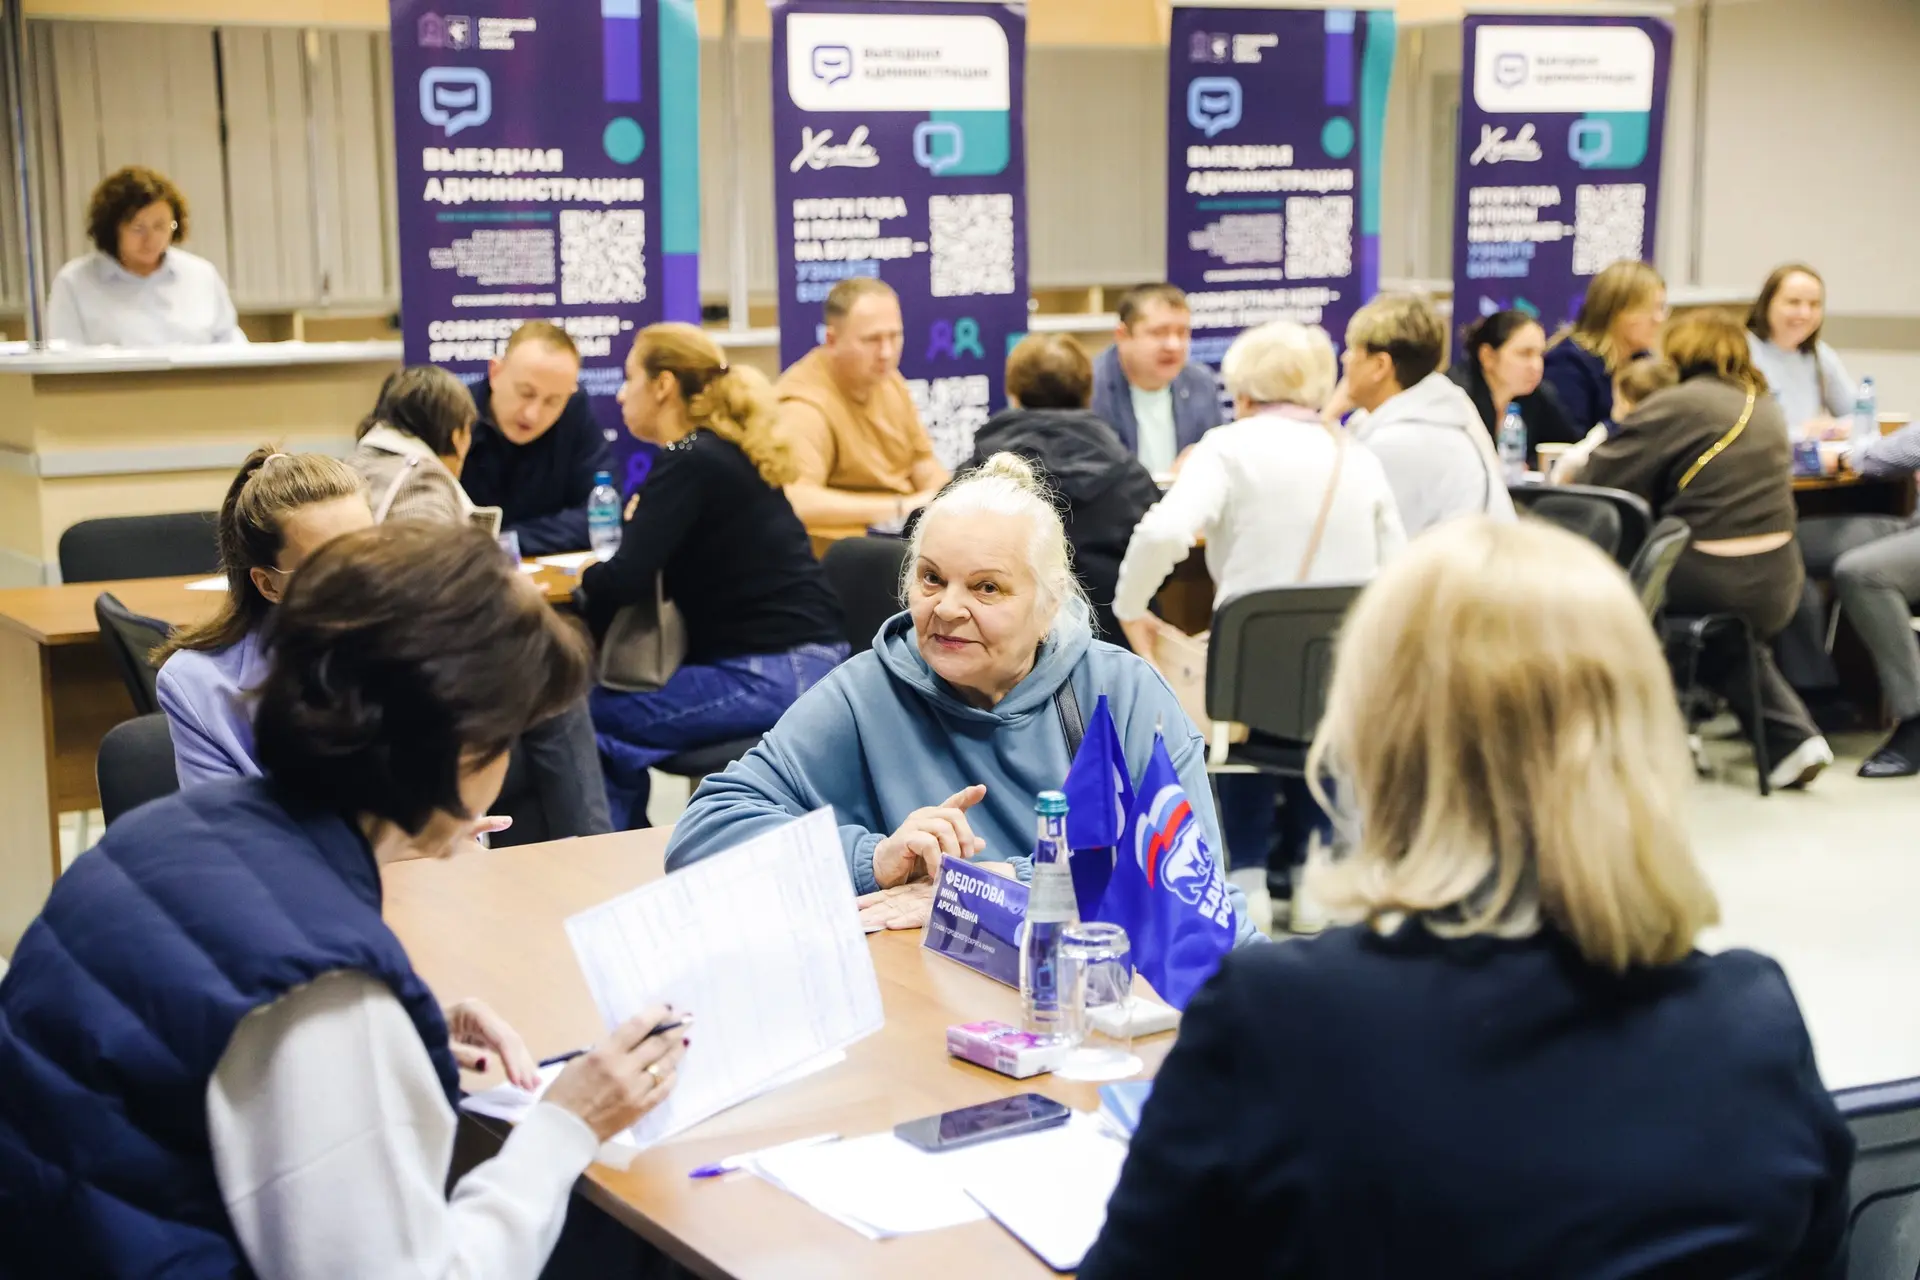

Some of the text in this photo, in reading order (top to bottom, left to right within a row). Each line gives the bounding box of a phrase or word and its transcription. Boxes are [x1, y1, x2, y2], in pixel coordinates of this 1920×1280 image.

[422, 147, 563, 175] ВЫЕЗДНАЯ
[1186, 145, 1294, 169] ВЫЕЗДНАЯ
[422, 178, 645, 205] АДМИНИСТРАЦИЯ
[1186, 169, 1353, 195] АДМИНИСТРАЦИЯ
[793, 196, 908, 220] ИТОГИ ГОДА
[793, 218, 880, 240] И ПЛАНЫ
[794, 241, 823, 261] НА
[824, 236, 912, 260] БУДУЩЕЕ
[565, 316, 620, 336] ИДЕИ
[940, 887, 959, 903] ИННА
[945, 869, 1006, 907] ФЕДОТОВА
[937, 899, 979, 924] АРКАДЬЕВНА
